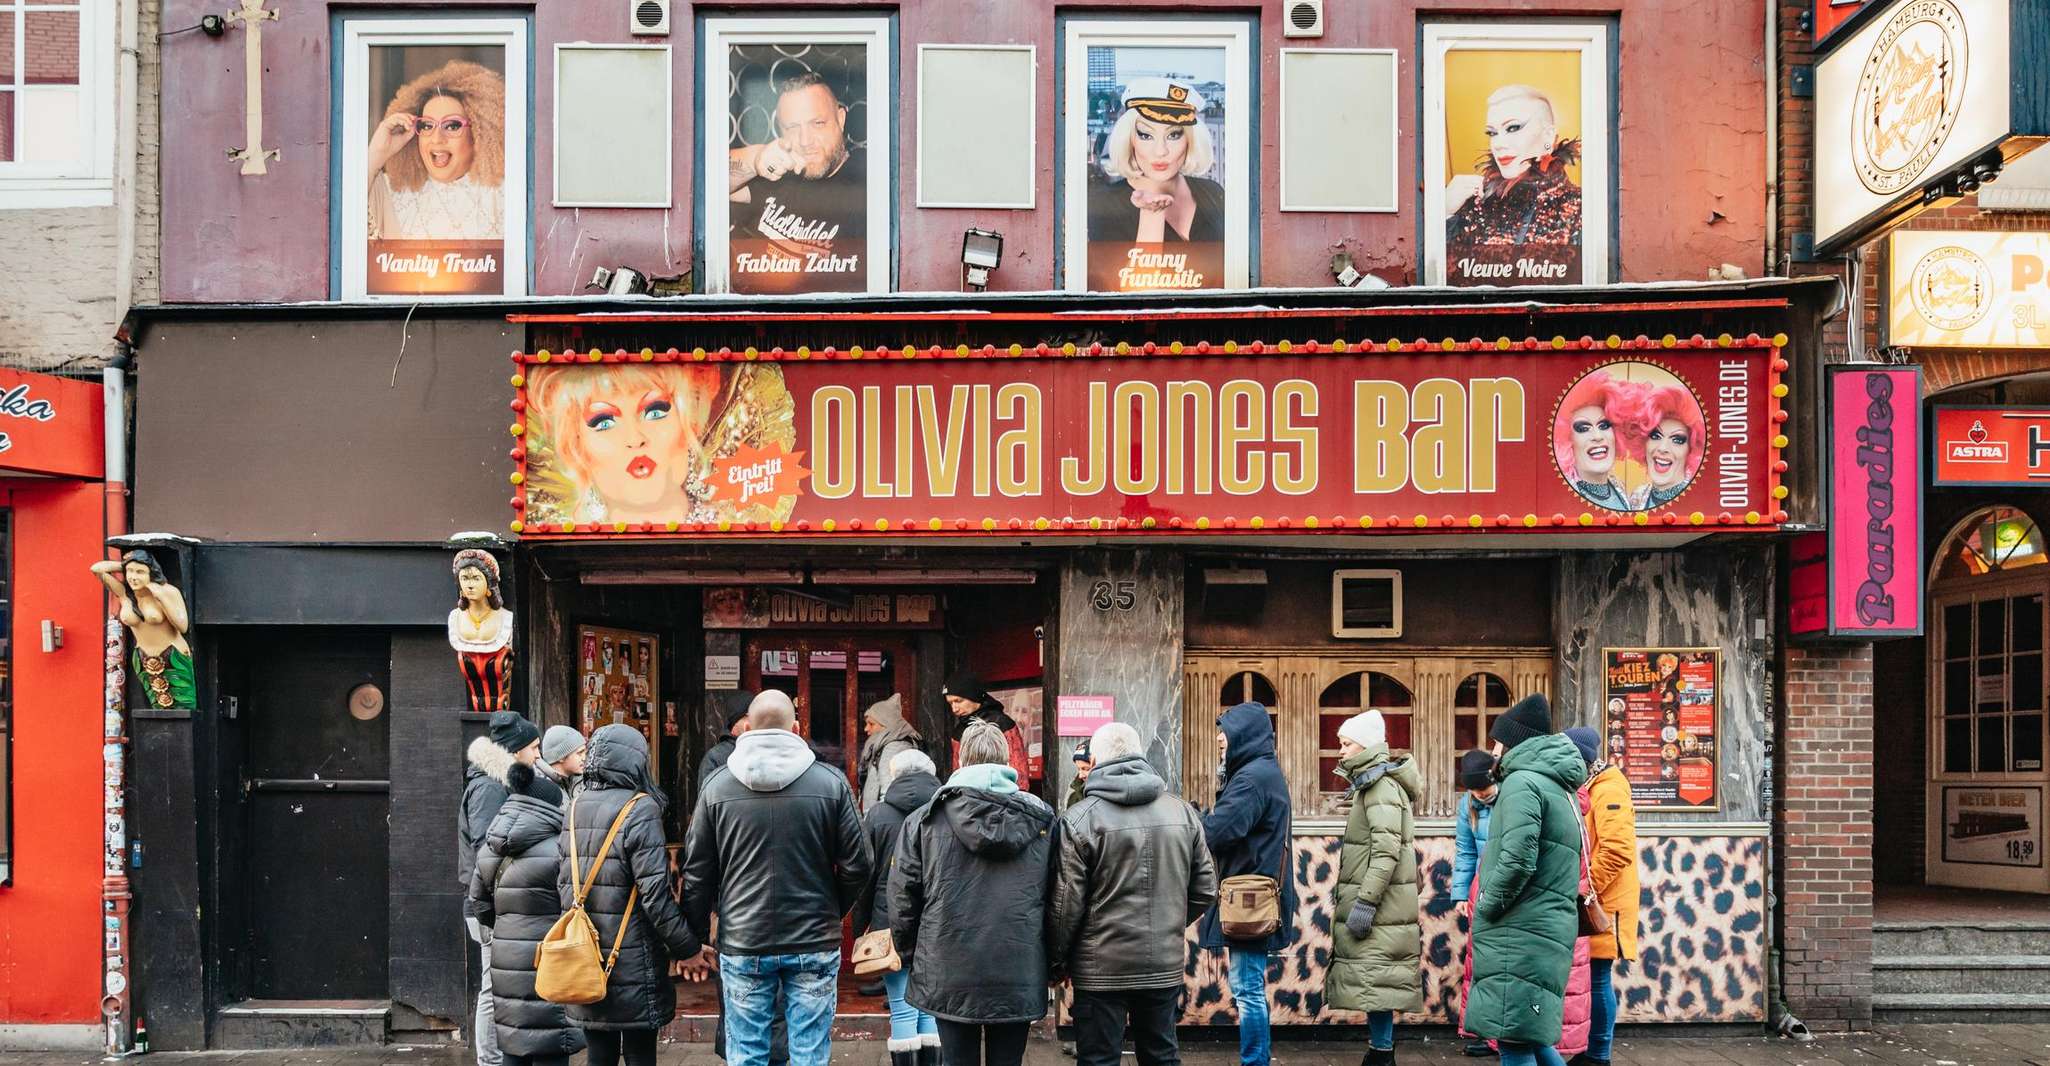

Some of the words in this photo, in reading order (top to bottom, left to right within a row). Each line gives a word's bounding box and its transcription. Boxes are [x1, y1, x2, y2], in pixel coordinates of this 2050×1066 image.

[1878, 2, 1938, 53] HAMBURG
[1877, 174, 1893, 189] ST.
[1898, 148, 1932, 186] PAULI
[376, 252, 440, 279] Vanity
[443, 252, 497, 274] Trash
[736, 252, 802, 273] Fabian
[804, 252, 858, 273] Zahrt
[1127, 247, 1188, 271] Fanny
[1457, 257, 1513, 278] Veuve
[1515, 257, 1568, 278] Noire
[1118, 267, 1204, 288] Funtastic
[2012, 254, 2050, 292] P
[0, 384, 56, 422] ka
[1719, 359, 1748, 508] OLIVIA-JONES.DE
[1952, 446, 2003, 458] ASTRA
[728, 458, 782, 484] Eintritt
[740, 475, 774, 503] frei!
[1856, 373, 1894, 626] Paradies
[1095, 581, 1137, 610] 35
[1609, 671, 1661, 685] TOUREN
[1624, 662, 1651, 674] KIEZ
